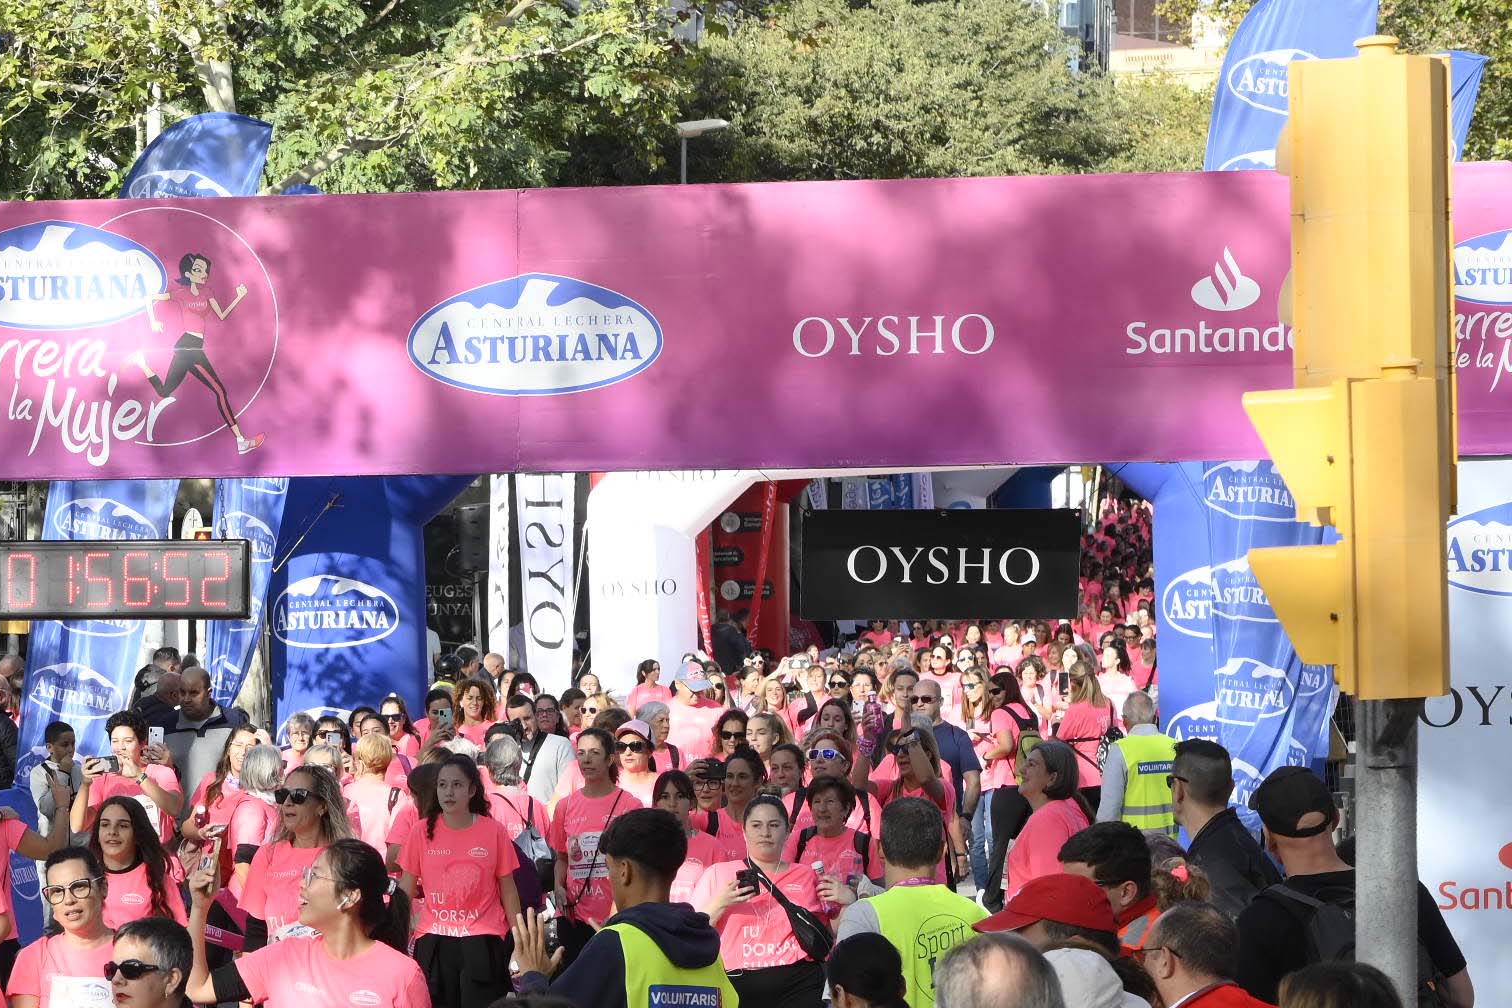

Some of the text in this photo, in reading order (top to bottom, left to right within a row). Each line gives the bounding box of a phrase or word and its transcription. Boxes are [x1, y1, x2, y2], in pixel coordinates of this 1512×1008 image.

[467, 312, 635, 330] CENTRAL LECHERA
[792, 313, 996, 358] OYSHO
[427, 320, 643, 367] ASTURIANA
[8, 379, 33, 422] la
[27, 373, 178, 468] Mujer
[847, 544, 1041, 586] OYSHO
[276, 603, 390, 632] ASTURIANA
[289, 599, 385, 609] CENTRAL LECHERA
[31, 676, 114, 712] ASTURIANA
[430, 892, 444, 904] TU
[431, 921, 471, 937] SUMA
[742, 924, 760, 939] TU
[917, 922, 965, 959] Sport
[650, 990, 717, 1008] VOLUNTARIS
